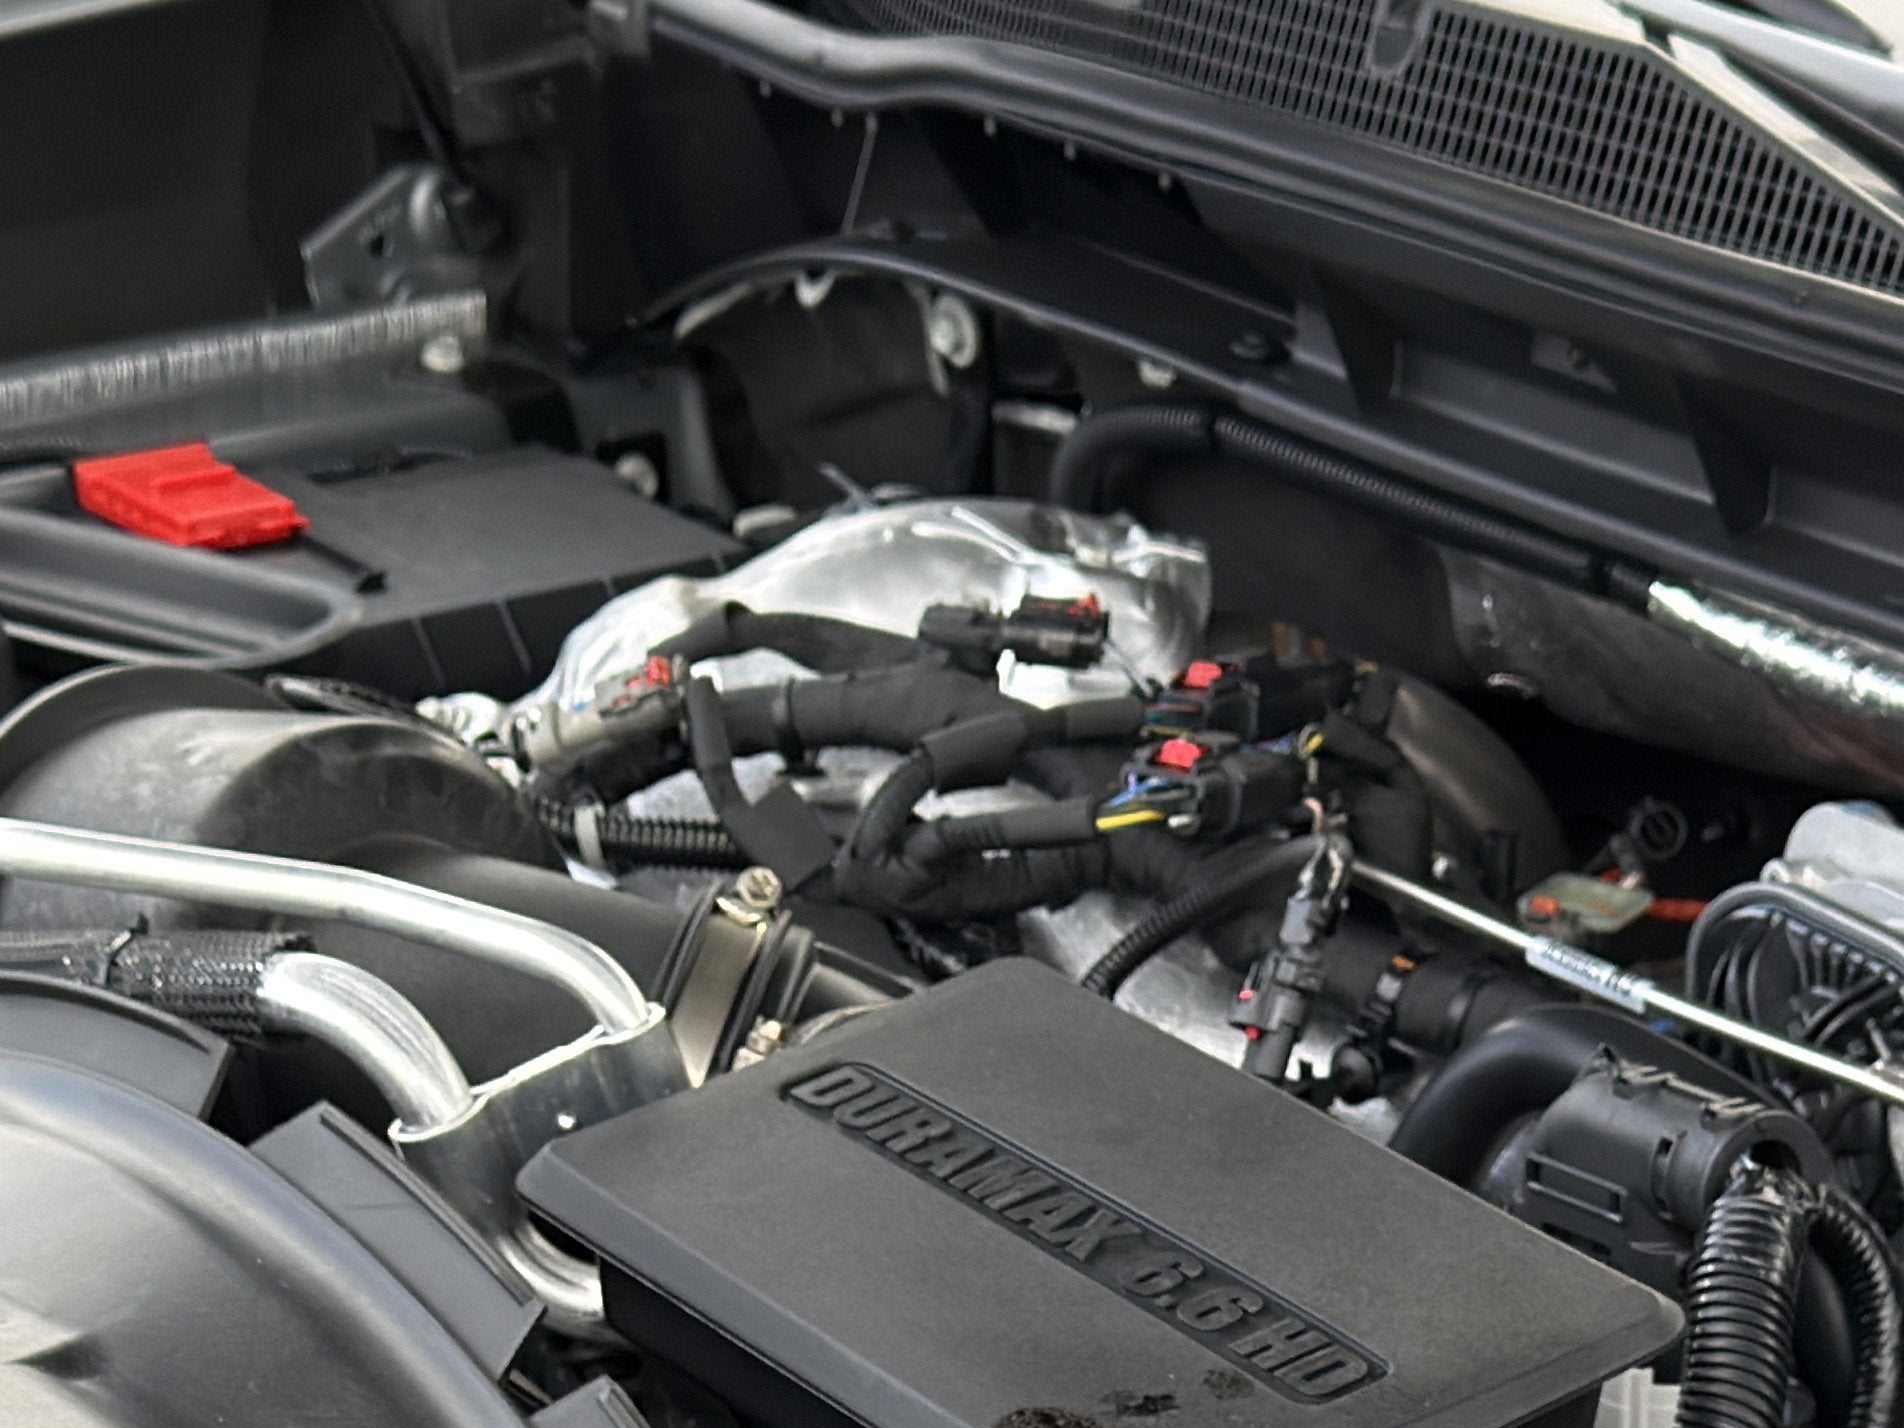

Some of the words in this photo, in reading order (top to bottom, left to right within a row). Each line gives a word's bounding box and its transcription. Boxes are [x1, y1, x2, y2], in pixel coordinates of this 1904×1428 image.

[789, 1065, 1143, 1262] DURAMAX
[1120, 1252, 1264, 1332] 6.6
[1228, 1321, 1369, 1399] HD
